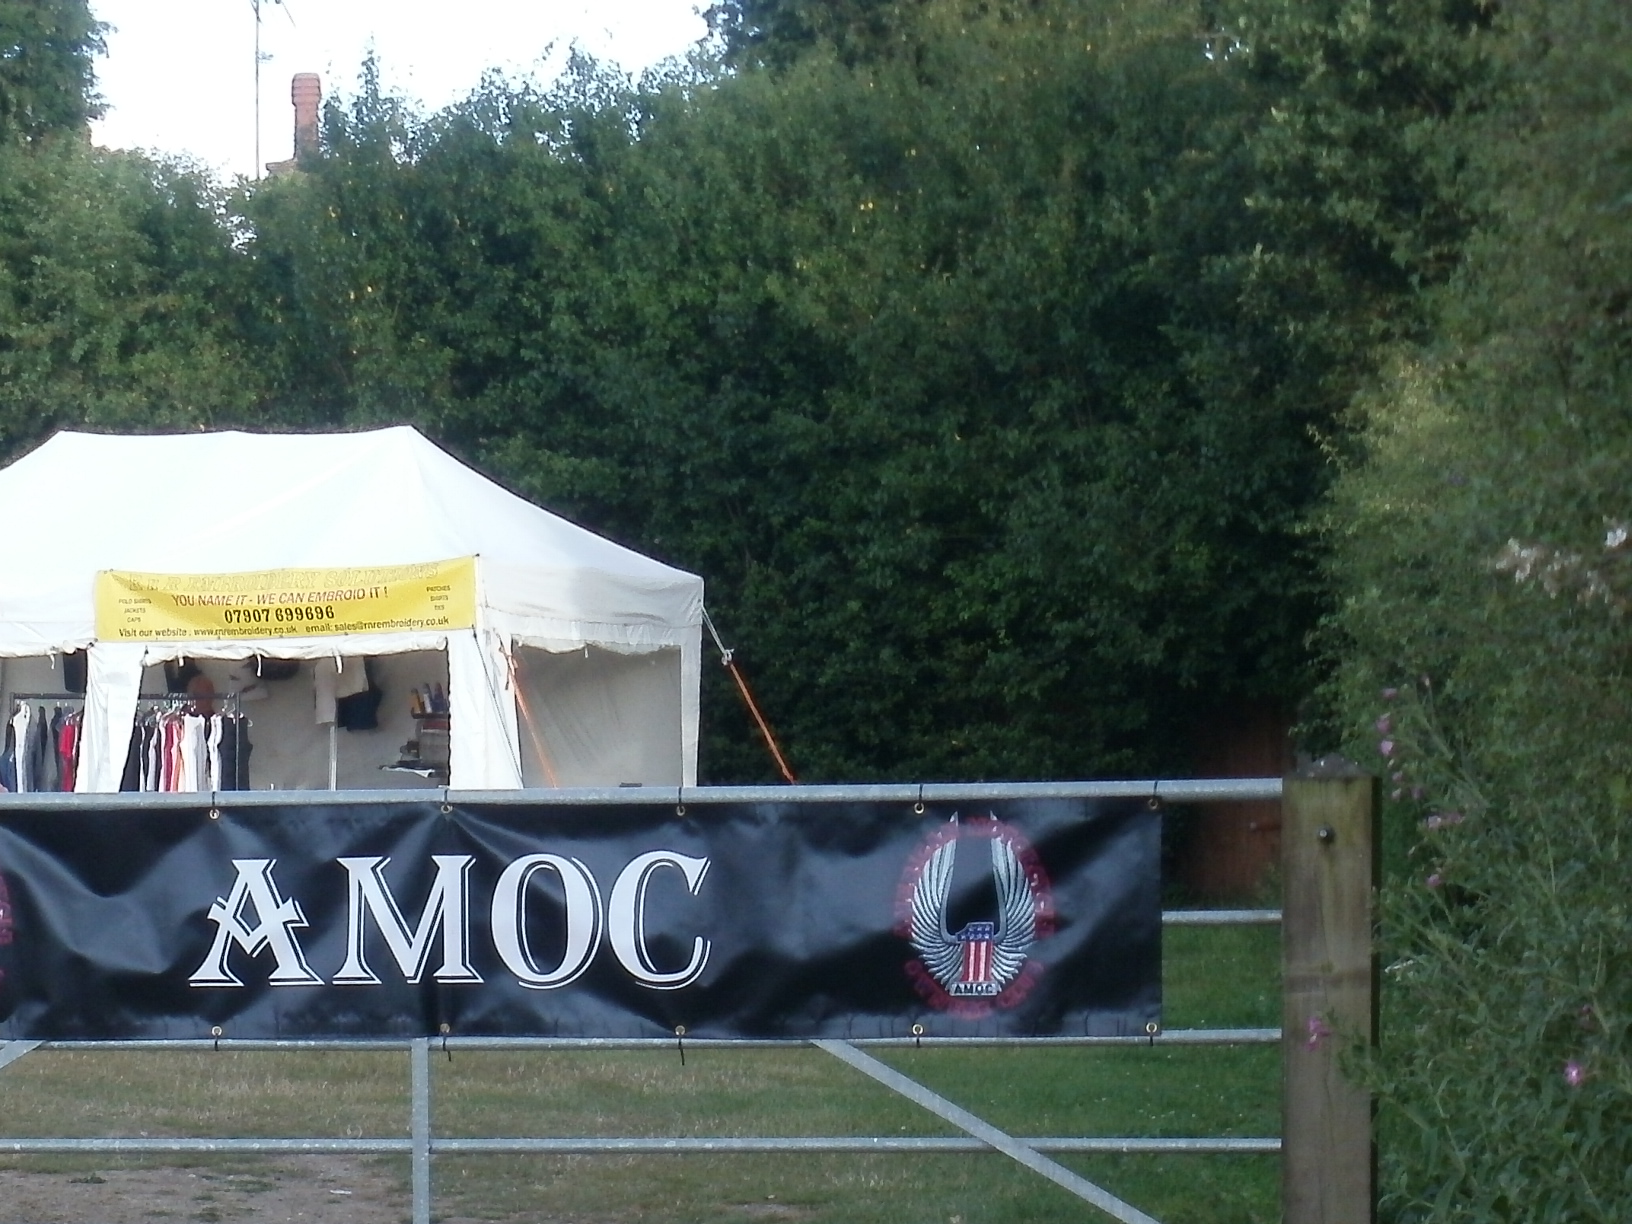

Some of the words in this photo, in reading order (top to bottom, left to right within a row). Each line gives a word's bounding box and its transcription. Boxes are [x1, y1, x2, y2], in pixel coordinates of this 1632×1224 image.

[171, 595, 196, 607] YOU
[196, 594, 233, 607] NAME
[235, 594, 249, 606] IT
[257, 593, 276, 605] WE
[278, 591, 305, 605] CAN
[307, 587, 366, 604] EMBROID
[369, 586, 381, 599] IT
[224, 608, 271, 624] 07907
[275, 605, 336, 622] 699696
[118, 628, 137, 638] Visit
[155, 627, 188, 638] website
[305, 623, 333, 634] email:
[187, 849, 712, 990] AMOC
[953, 982, 995, 995] AMOC
